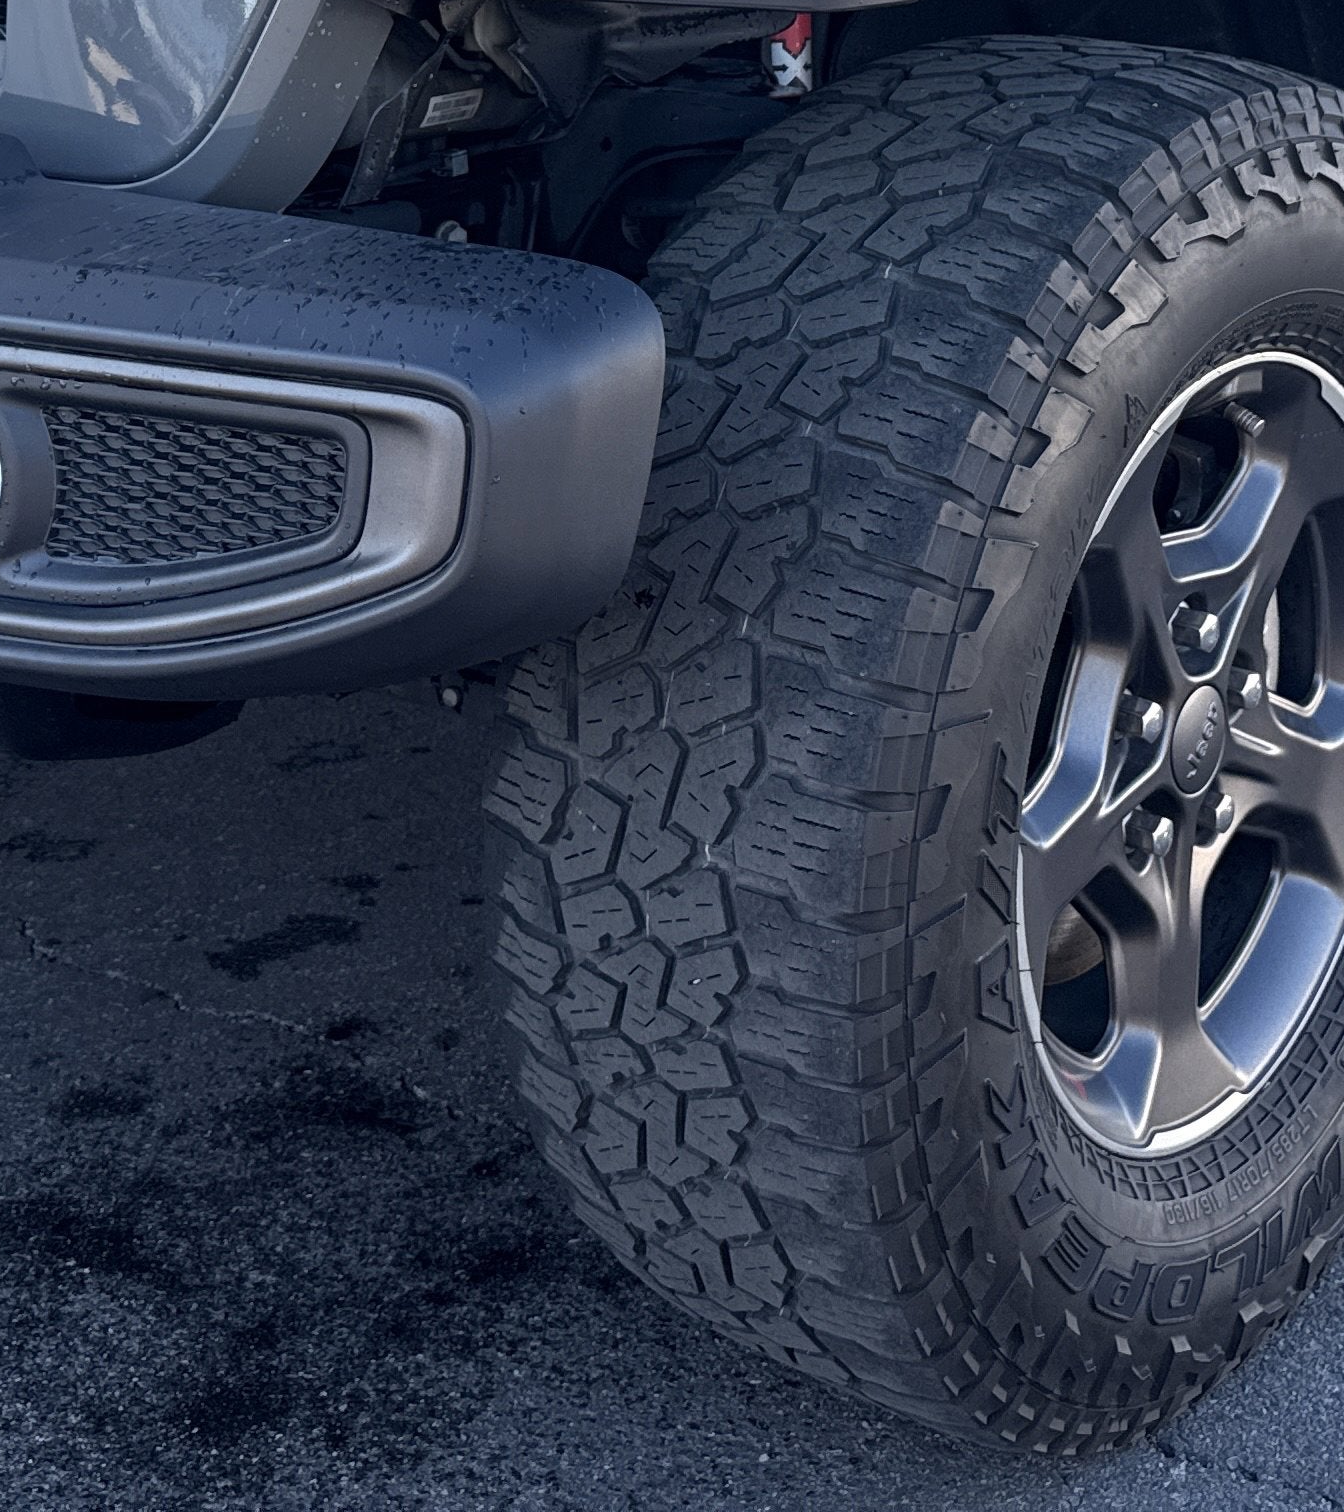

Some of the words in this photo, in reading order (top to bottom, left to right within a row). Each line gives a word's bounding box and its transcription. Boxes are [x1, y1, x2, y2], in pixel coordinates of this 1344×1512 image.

[1186, 701, 1218, 779] Jeep
[985, 1064, 1342, 1326] WILDPEAK
[1226, 1104, 1319, 1205] LT285/70R17
